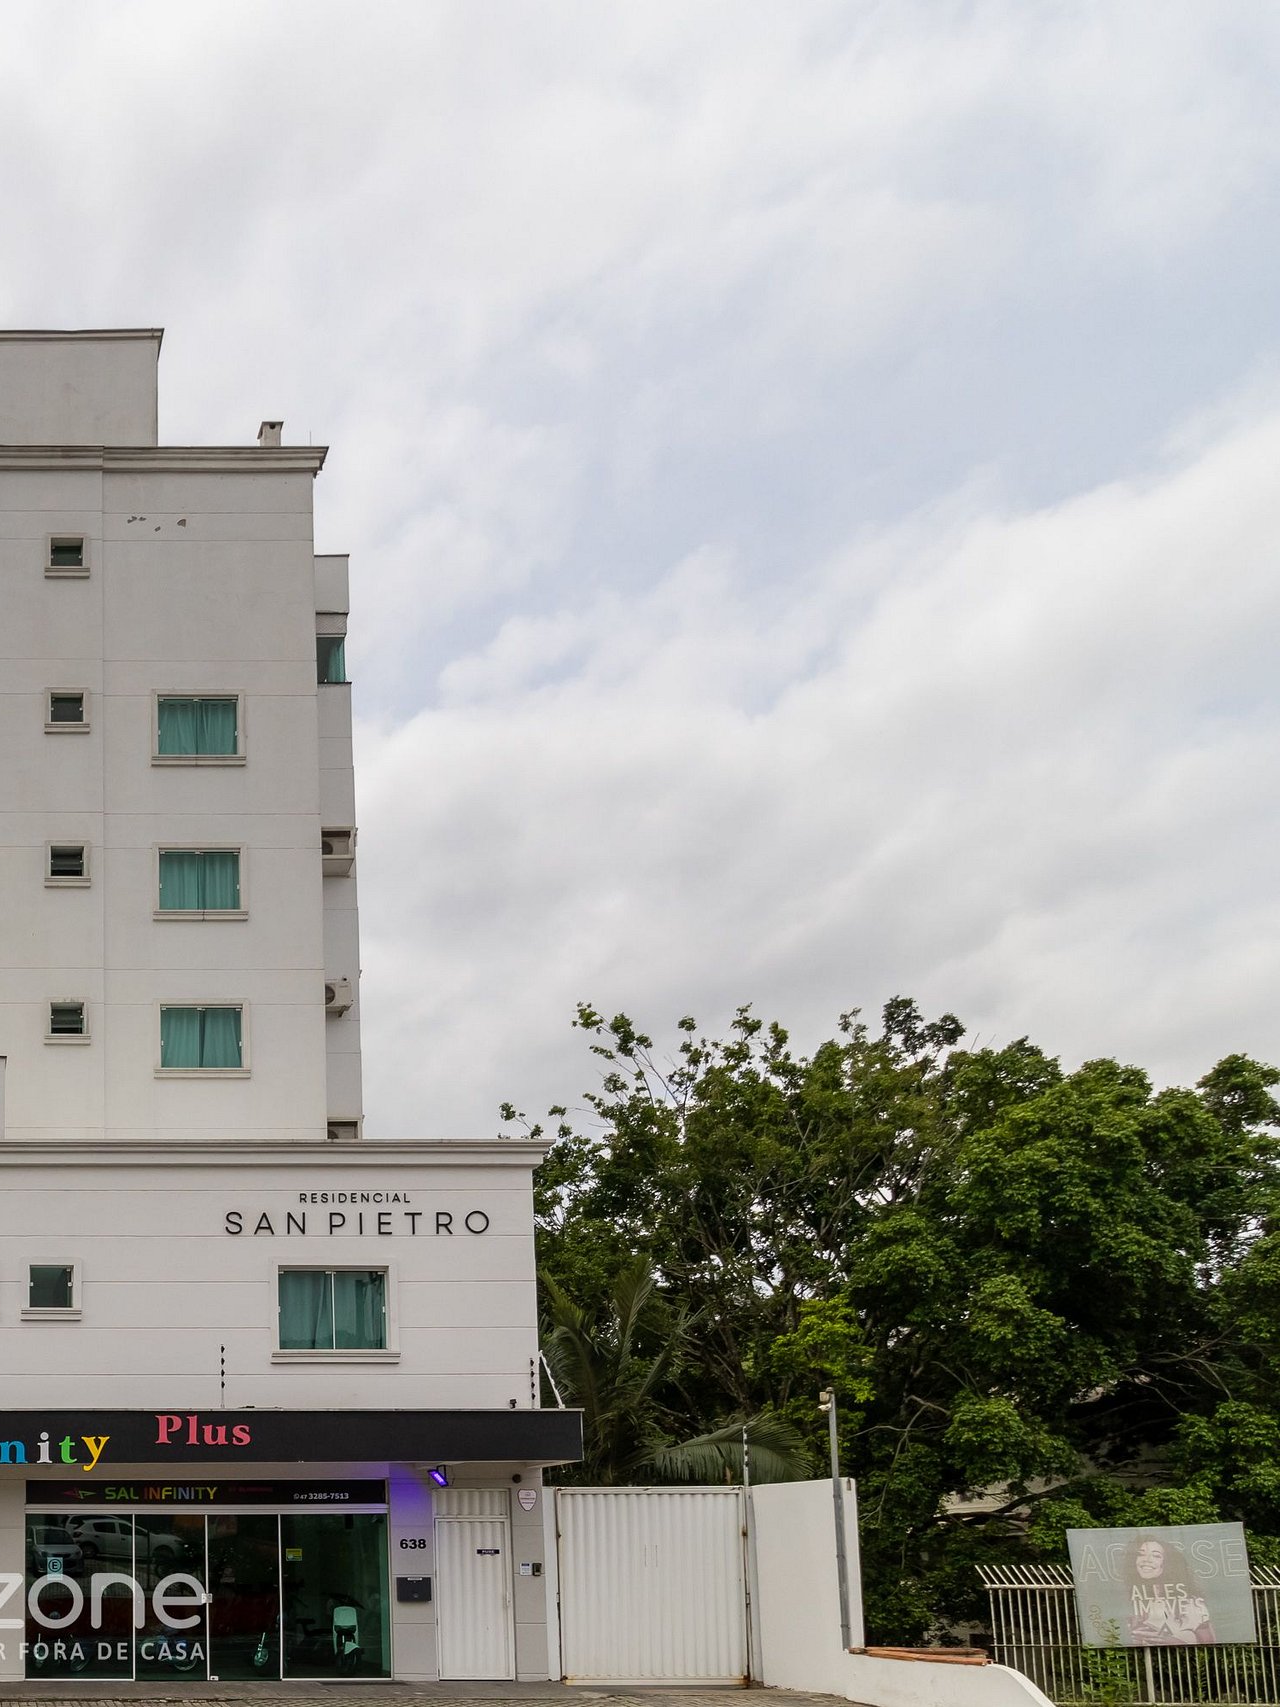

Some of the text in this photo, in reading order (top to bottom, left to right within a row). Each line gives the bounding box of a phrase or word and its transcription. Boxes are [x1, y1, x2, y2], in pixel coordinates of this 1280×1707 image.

[299, 1193, 411, 1204] RESIDENCIAL
[225, 1210, 489, 1235] SAN PIETRO
[155, 1415, 251, 1446] Plus
[105, 1487, 138, 1499] SAL
[144, 1487, 217, 1500] INFINITY
[400, 1539, 426, 1550] 638
[1131, 1583, 1188, 1600] ALLES
